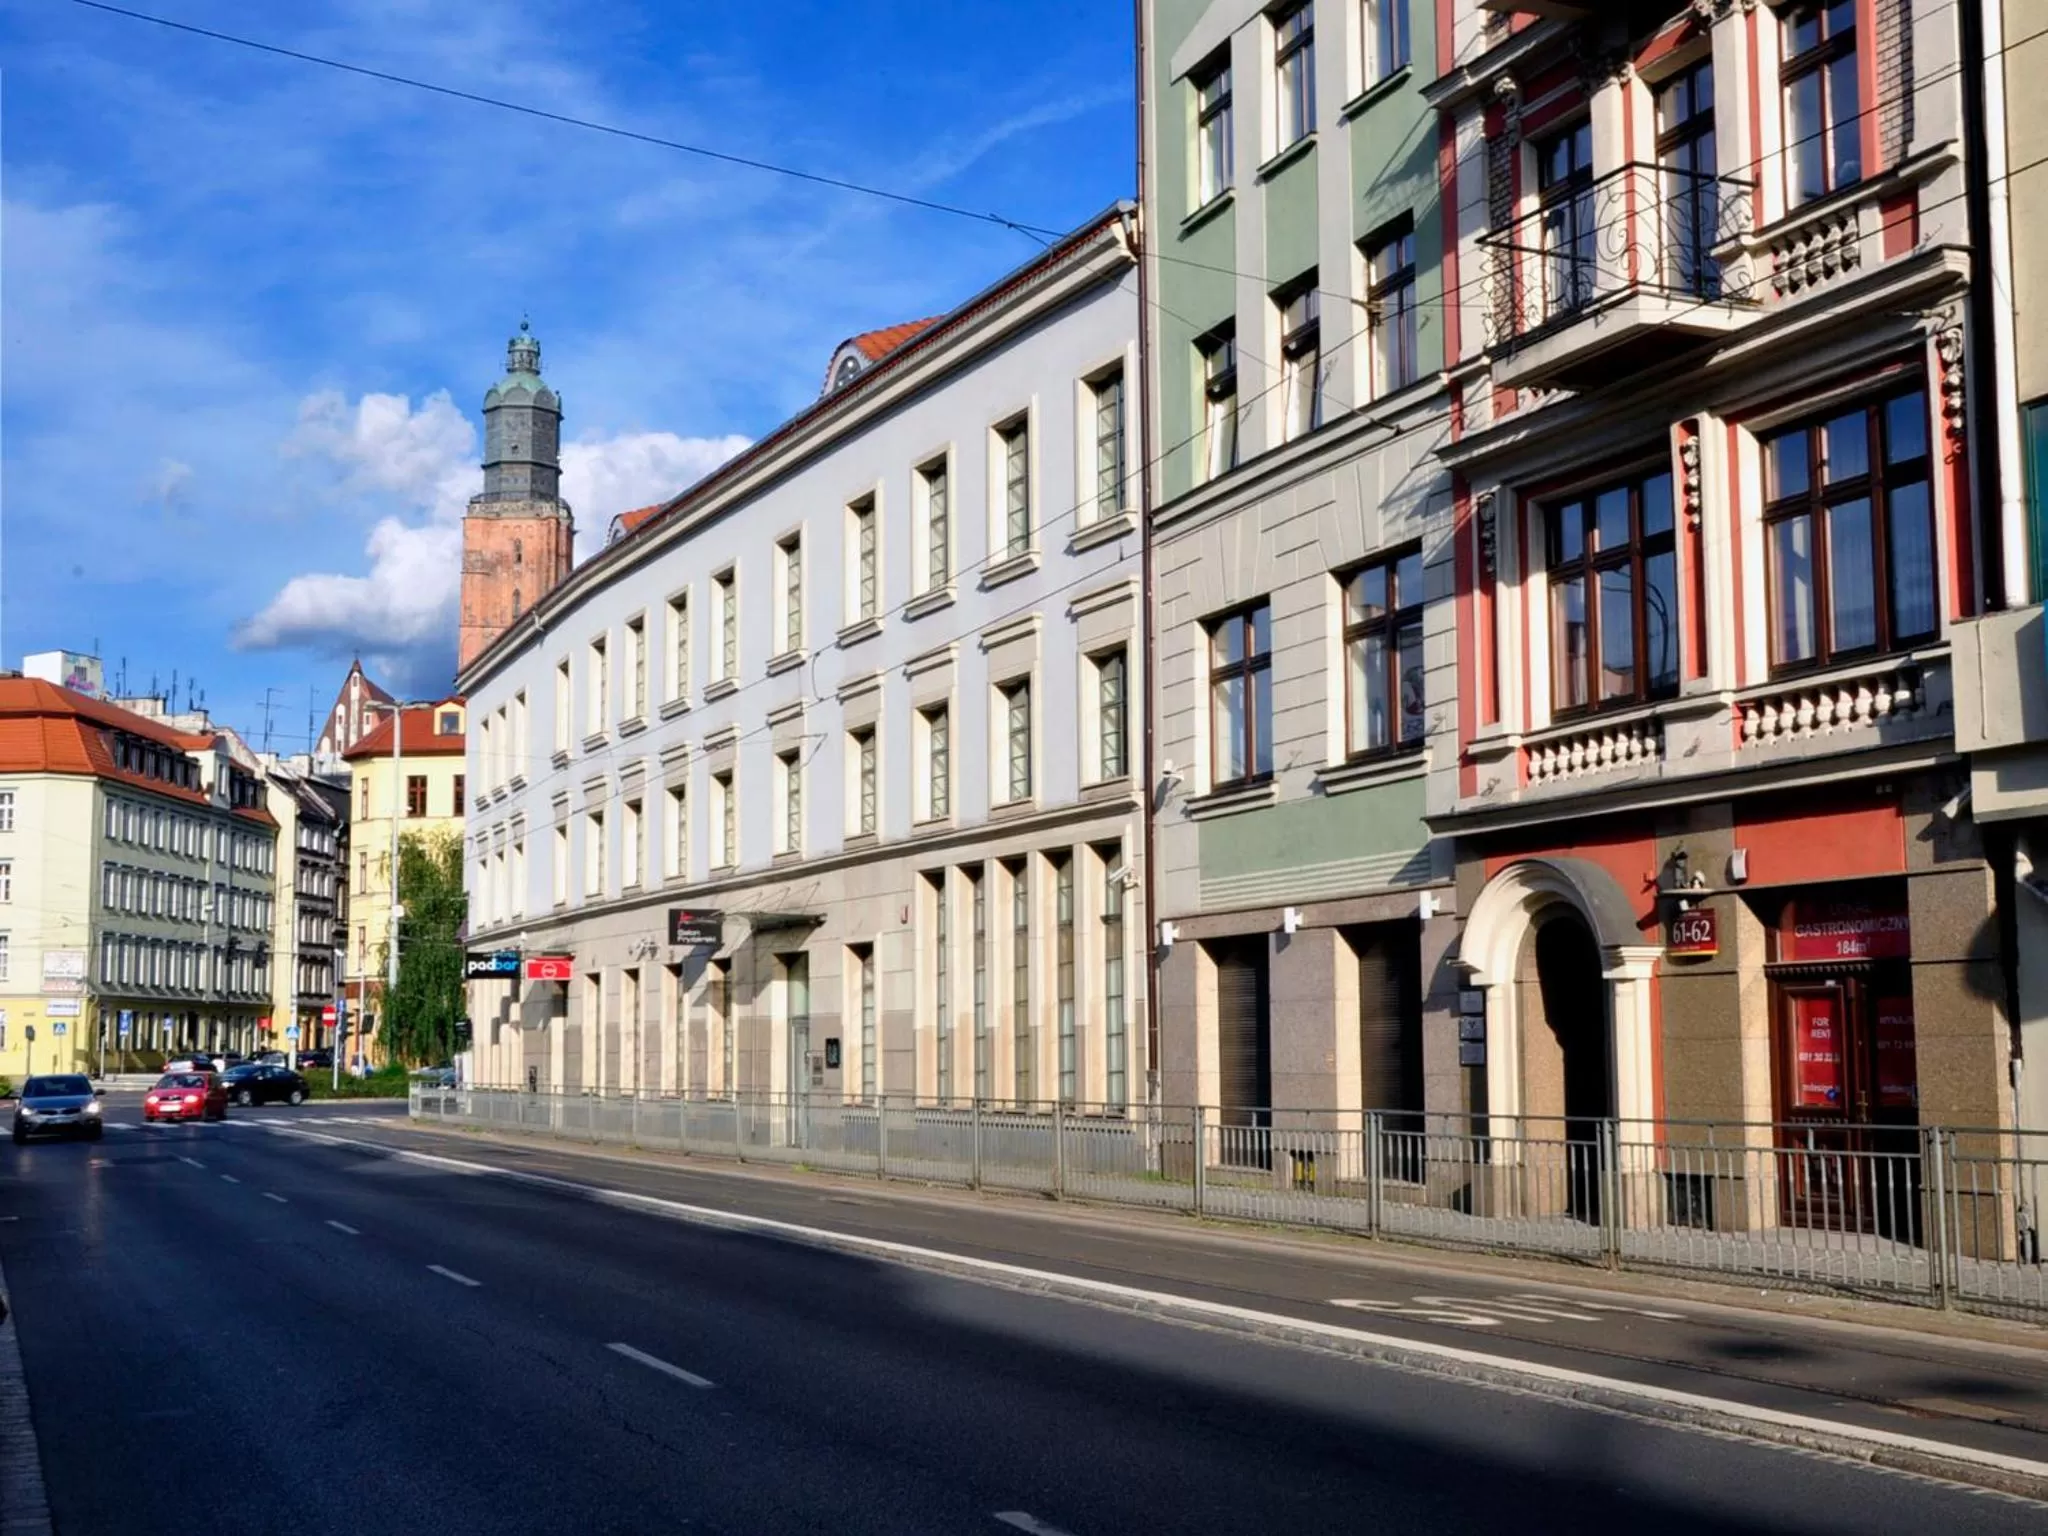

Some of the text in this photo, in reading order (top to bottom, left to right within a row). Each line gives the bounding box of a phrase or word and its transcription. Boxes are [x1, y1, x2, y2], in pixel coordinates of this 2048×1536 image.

[1672, 919, 1712, 945] 61-62
[468, 957, 519, 975] padbar
[1812, 1016, 1830, 1027] FOR
[1810, 1028, 1832, 1039] RENT
